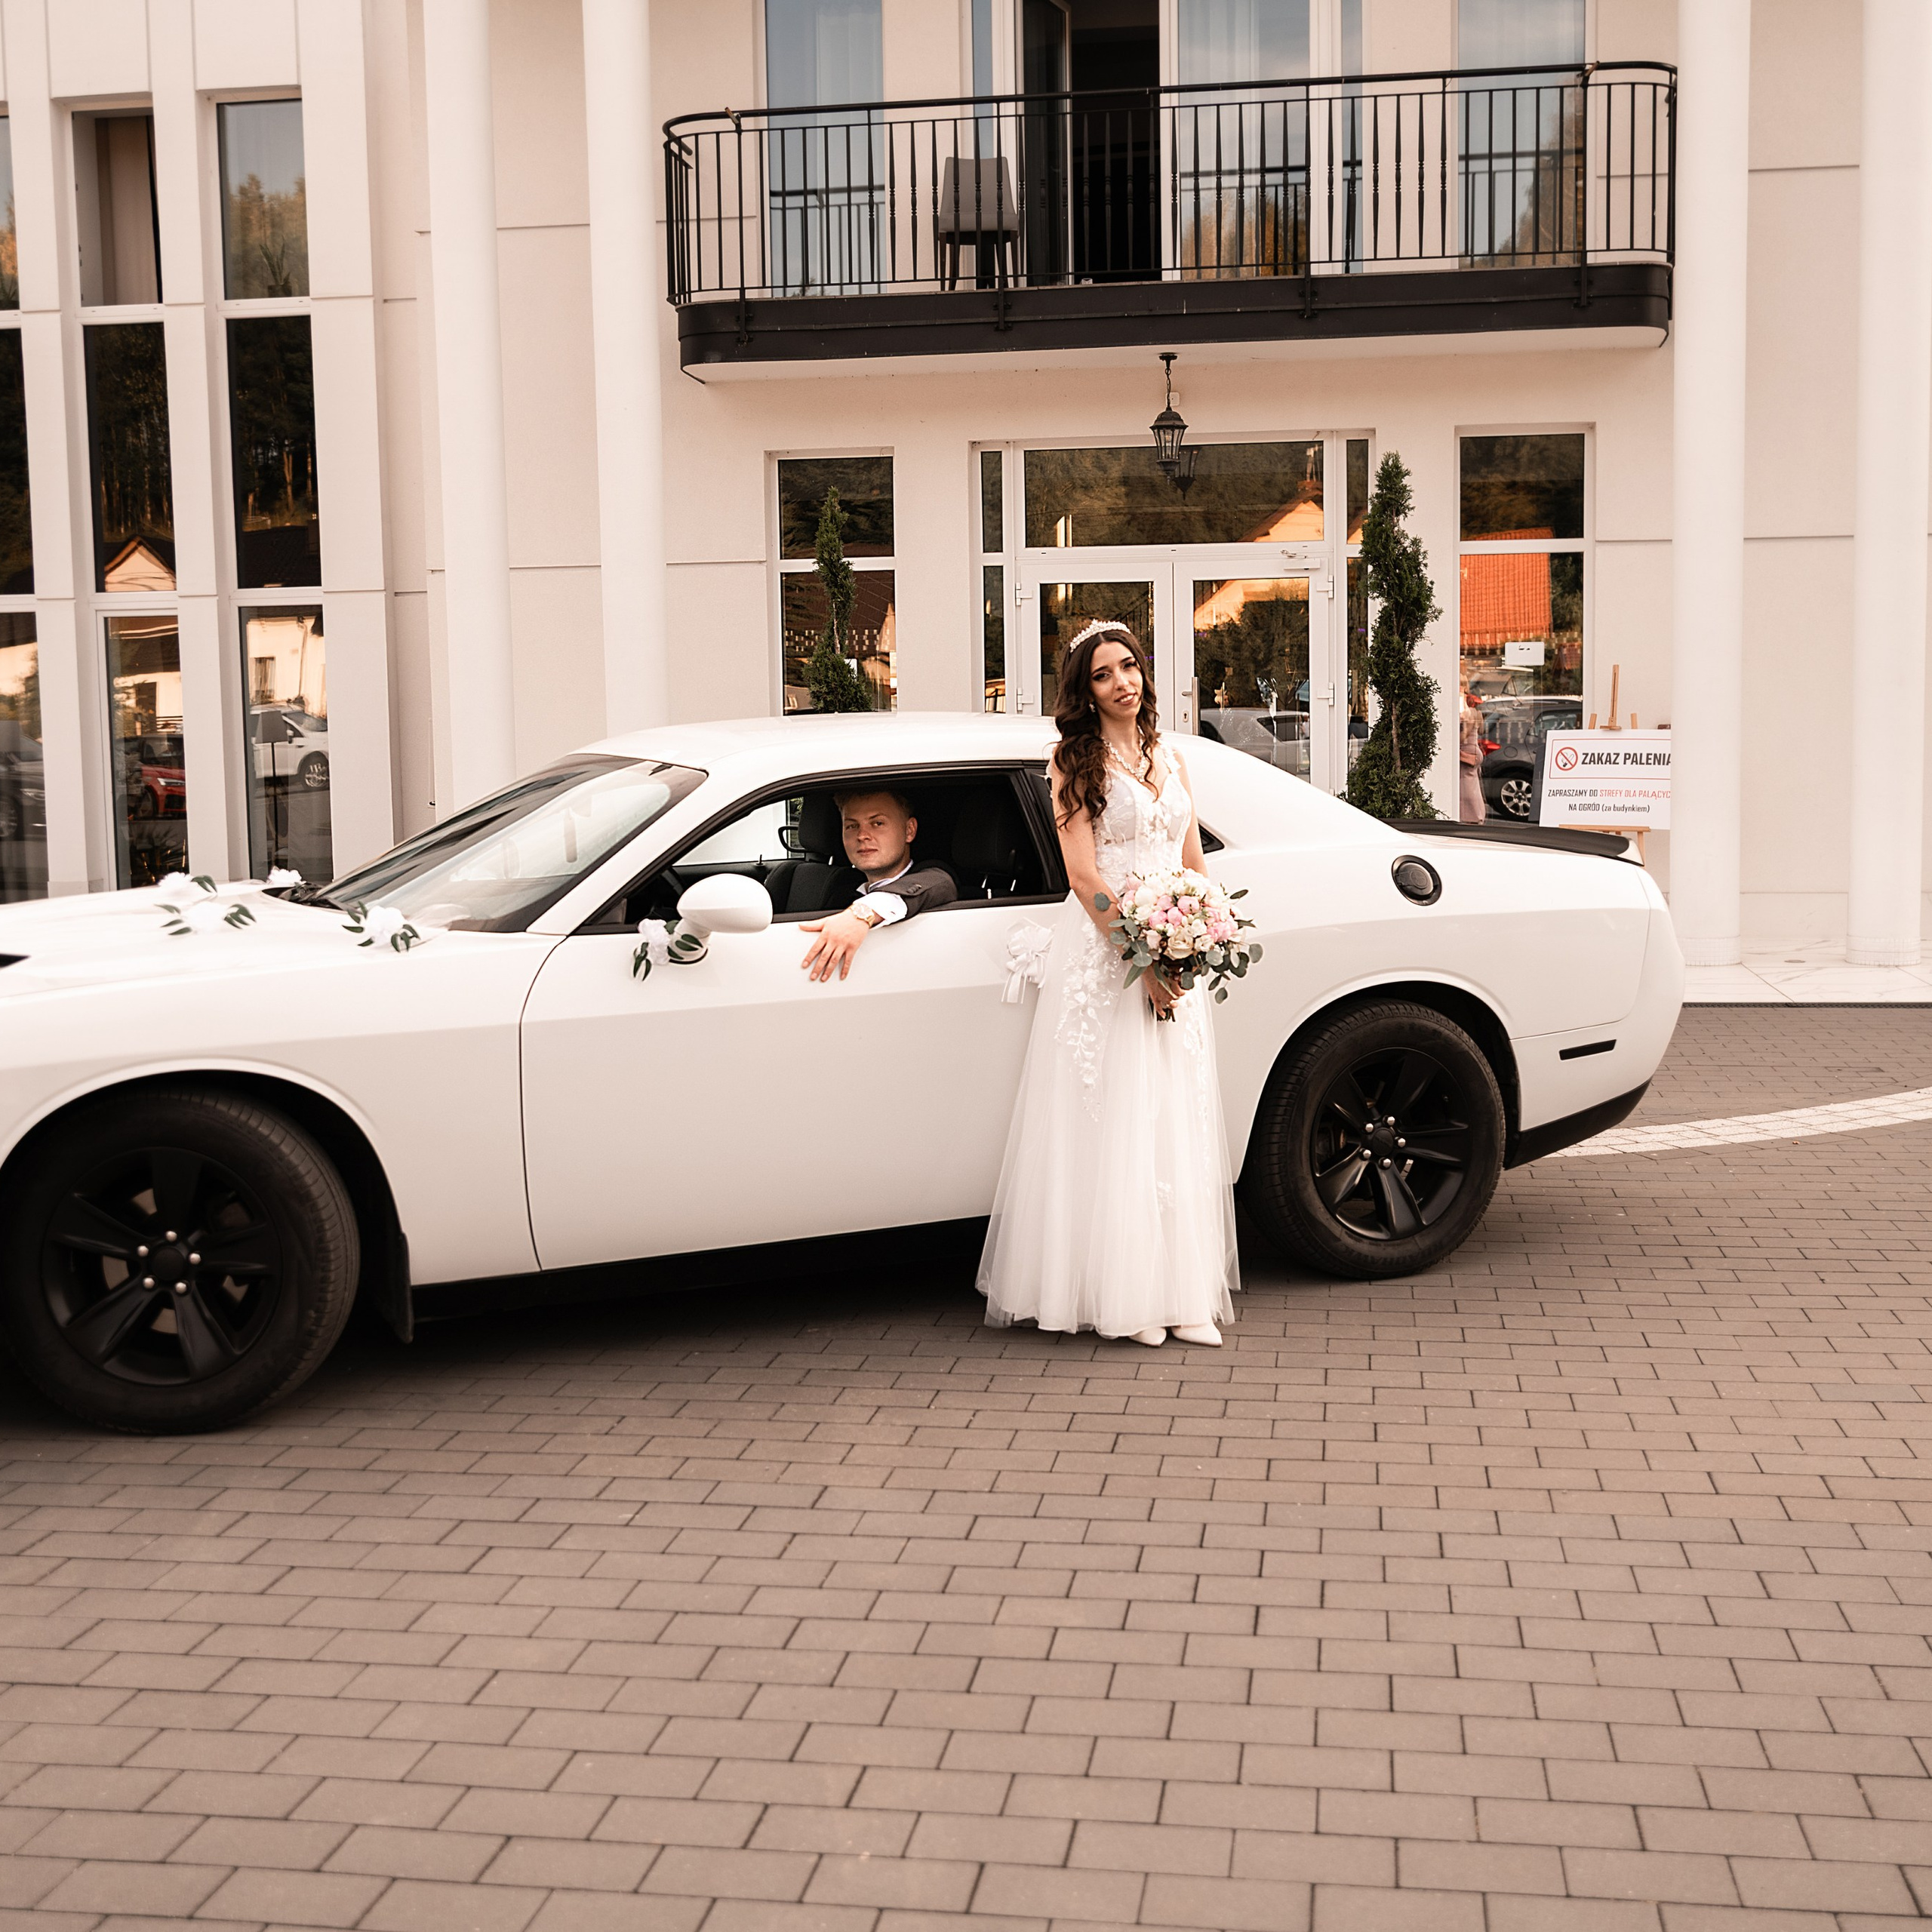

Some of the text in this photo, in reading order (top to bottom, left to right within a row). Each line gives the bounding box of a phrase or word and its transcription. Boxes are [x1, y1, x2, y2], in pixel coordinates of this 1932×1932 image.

[1581, 752, 1671, 766] ZAKAZ PALENIA
[1548, 789, 1671, 800] ZAPRASZAMY DO STREFY DLA PALĄCYC
[1568, 801, 1651, 814] NA OGRÓD (za budynkiem)
